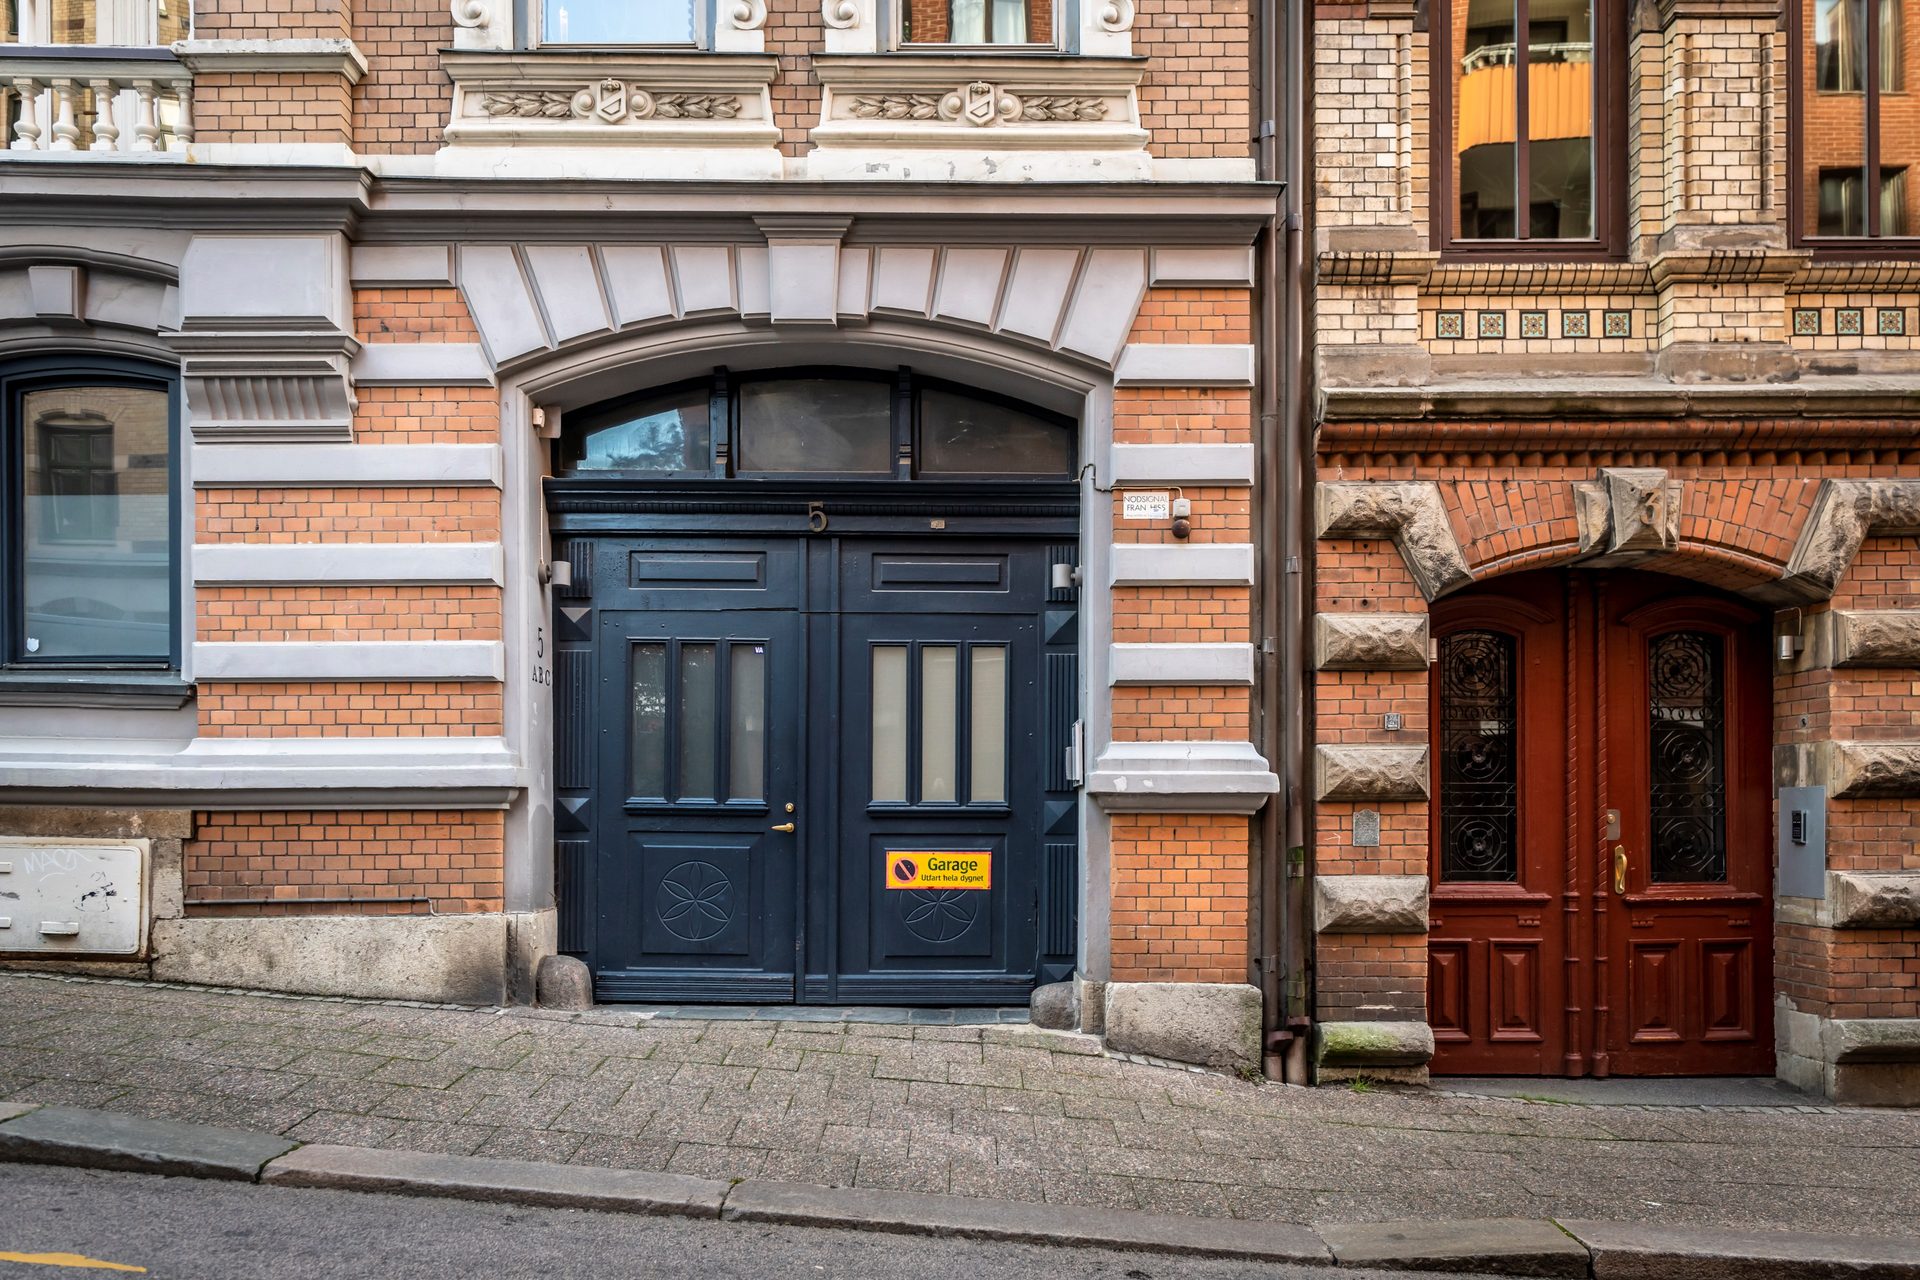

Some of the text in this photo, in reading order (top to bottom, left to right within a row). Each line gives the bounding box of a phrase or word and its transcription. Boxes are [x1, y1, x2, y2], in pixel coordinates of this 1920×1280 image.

[808, 501, 828, 533] 5
[537, 627, 544, 658] 5
[532, 664, 551, 686] ABC
[927, 857, 978, 874] Garage
[921, 874, 984, 883] Utfart hela dygnet
